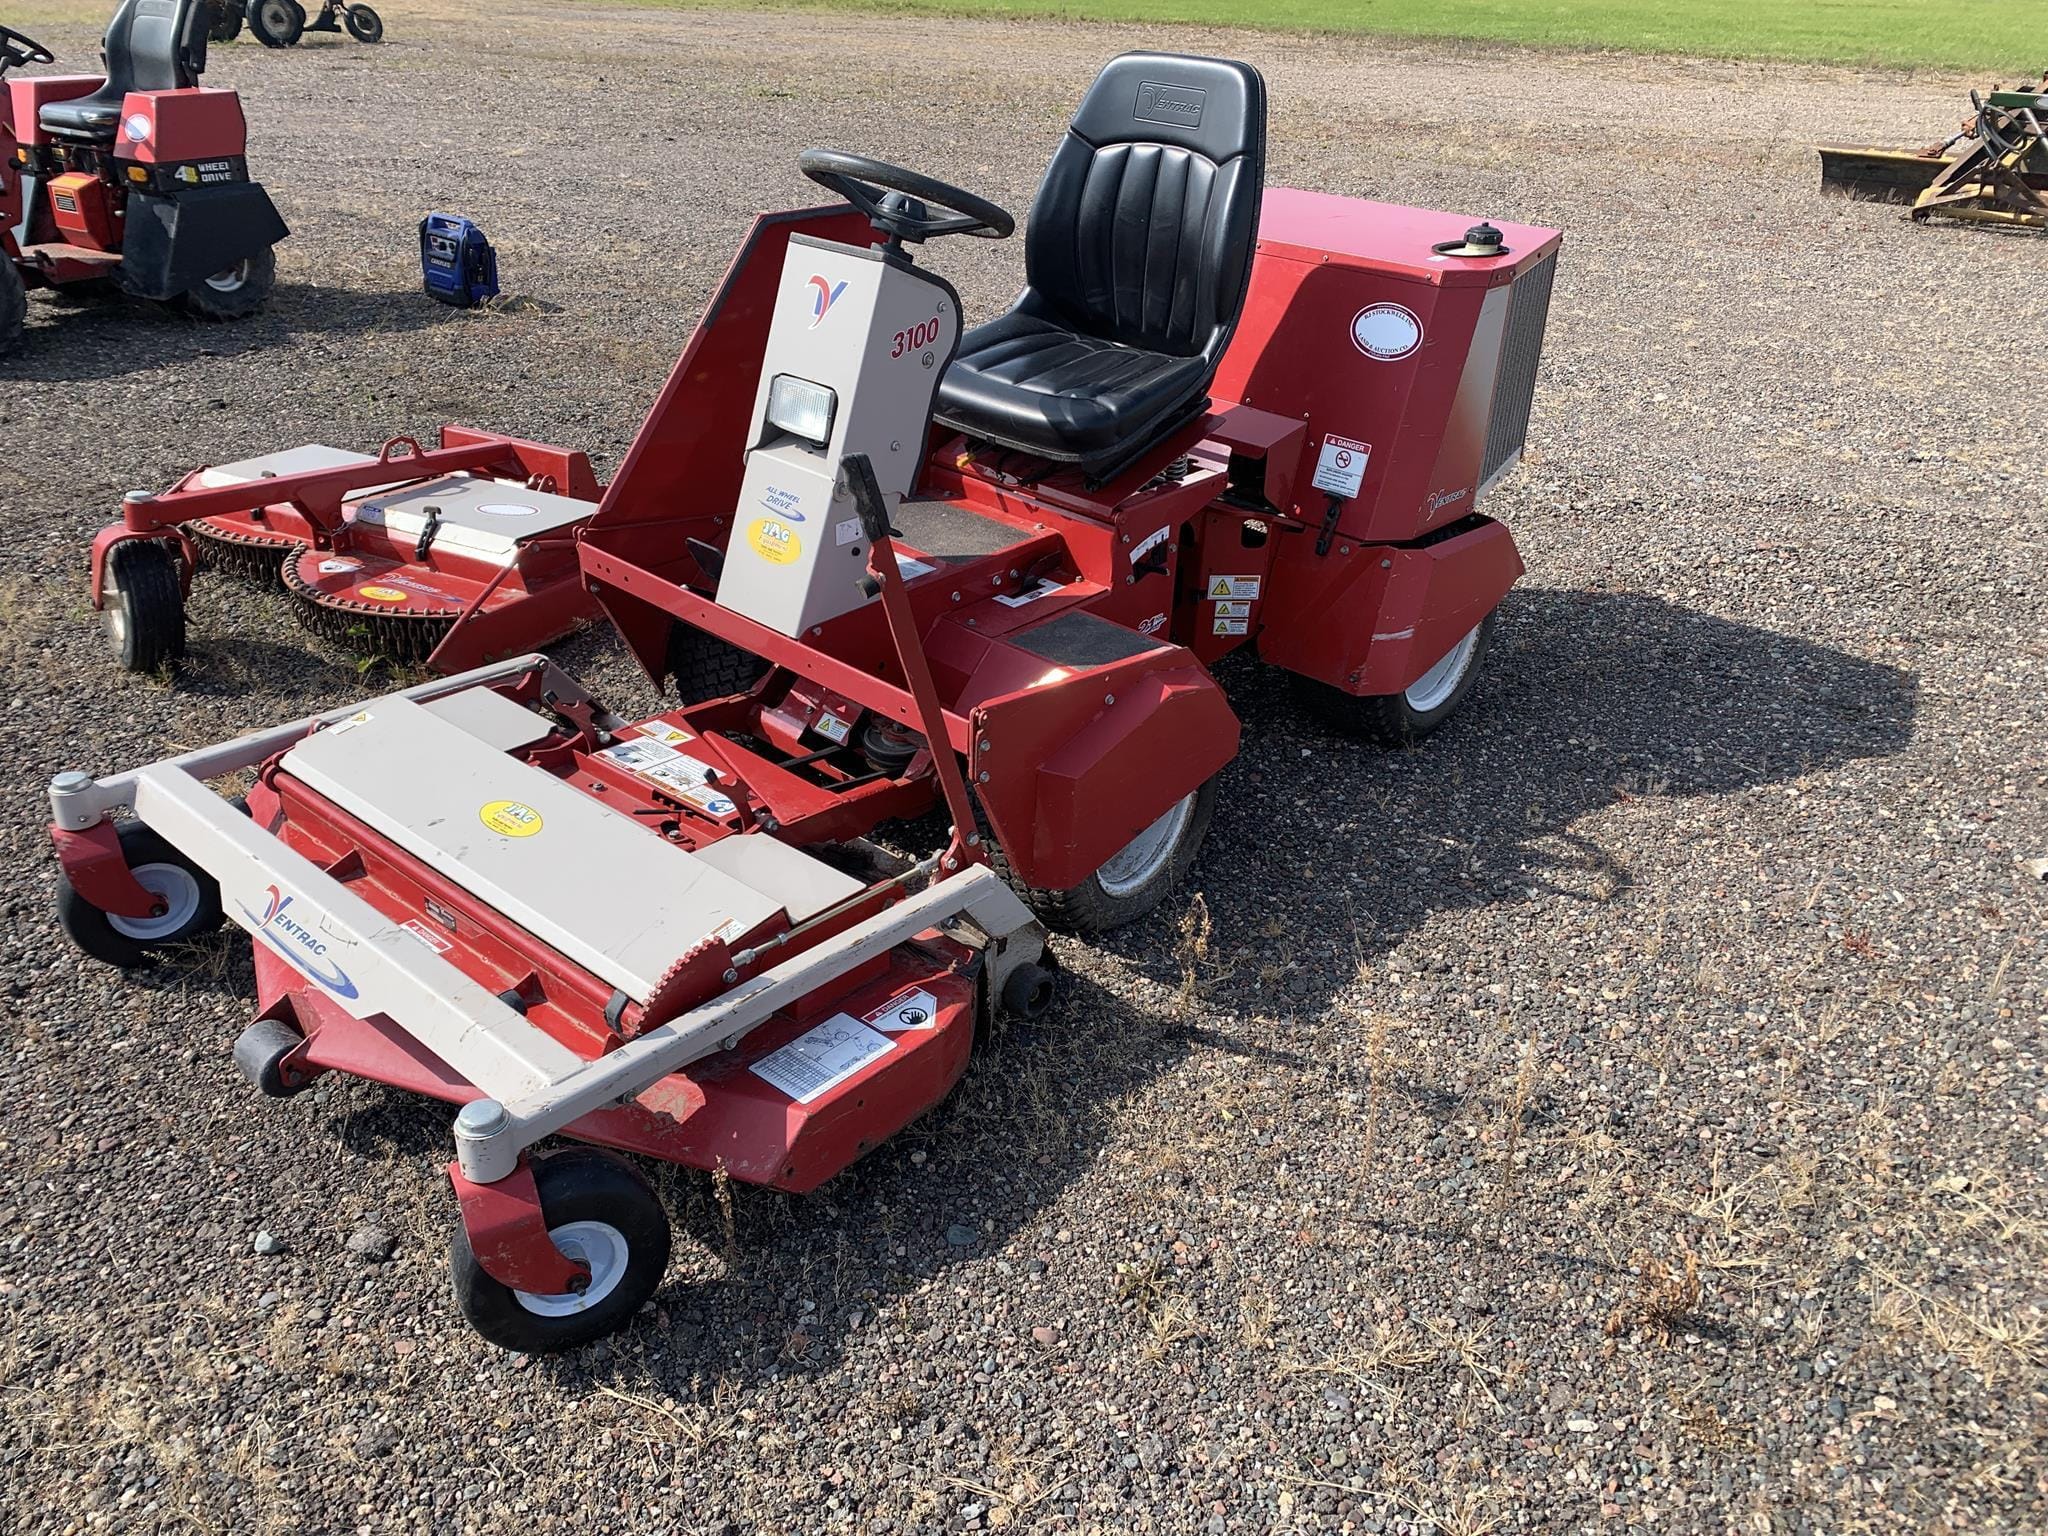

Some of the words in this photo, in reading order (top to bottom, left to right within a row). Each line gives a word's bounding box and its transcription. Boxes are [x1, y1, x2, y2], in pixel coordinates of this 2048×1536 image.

[198, 162, 230, 172] WHEEL
[201, 172, 232, 182] DRIVE
[890, 316, 940, 359] 3100
[1358, 332, 1370, 346] LAND
[1374, 346, 1399, 354] AUCTION
[1337, 439, 1365, 452] DANGER
[766, 486, 778, 495] ALL
[778, 490, 801, 504] WHEEL
[766, 495, 792, 510] DRIVE
[260, 884, 328, 957] VENTRAC
[881, 994, 910, 1012] DANGER
